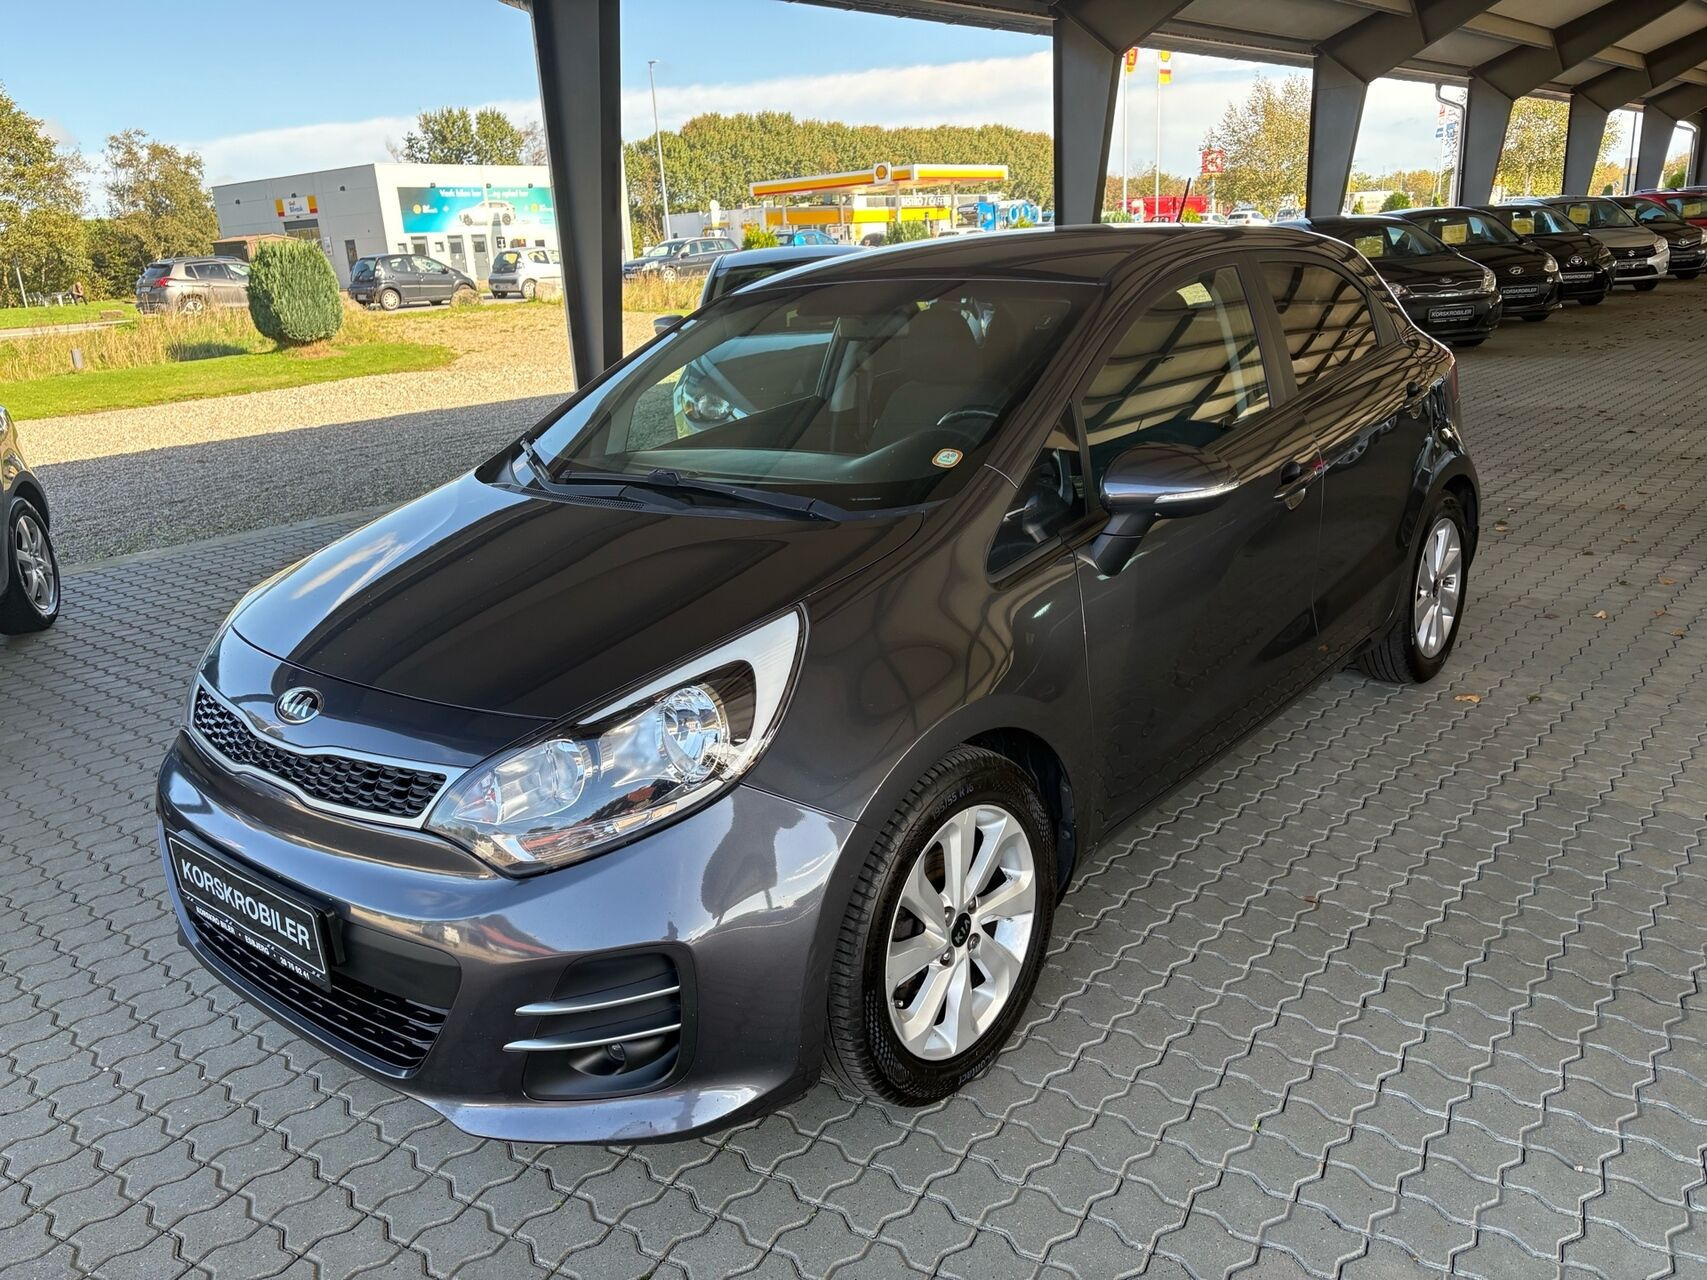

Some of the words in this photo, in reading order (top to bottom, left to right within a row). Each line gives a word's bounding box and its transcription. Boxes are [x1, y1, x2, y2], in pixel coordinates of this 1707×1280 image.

[1431, 309, 1472, 318] KORSKROBILER
[181, 858, 311, 951] KORSKROBILER
[954, 918, 971, 945] KIA
